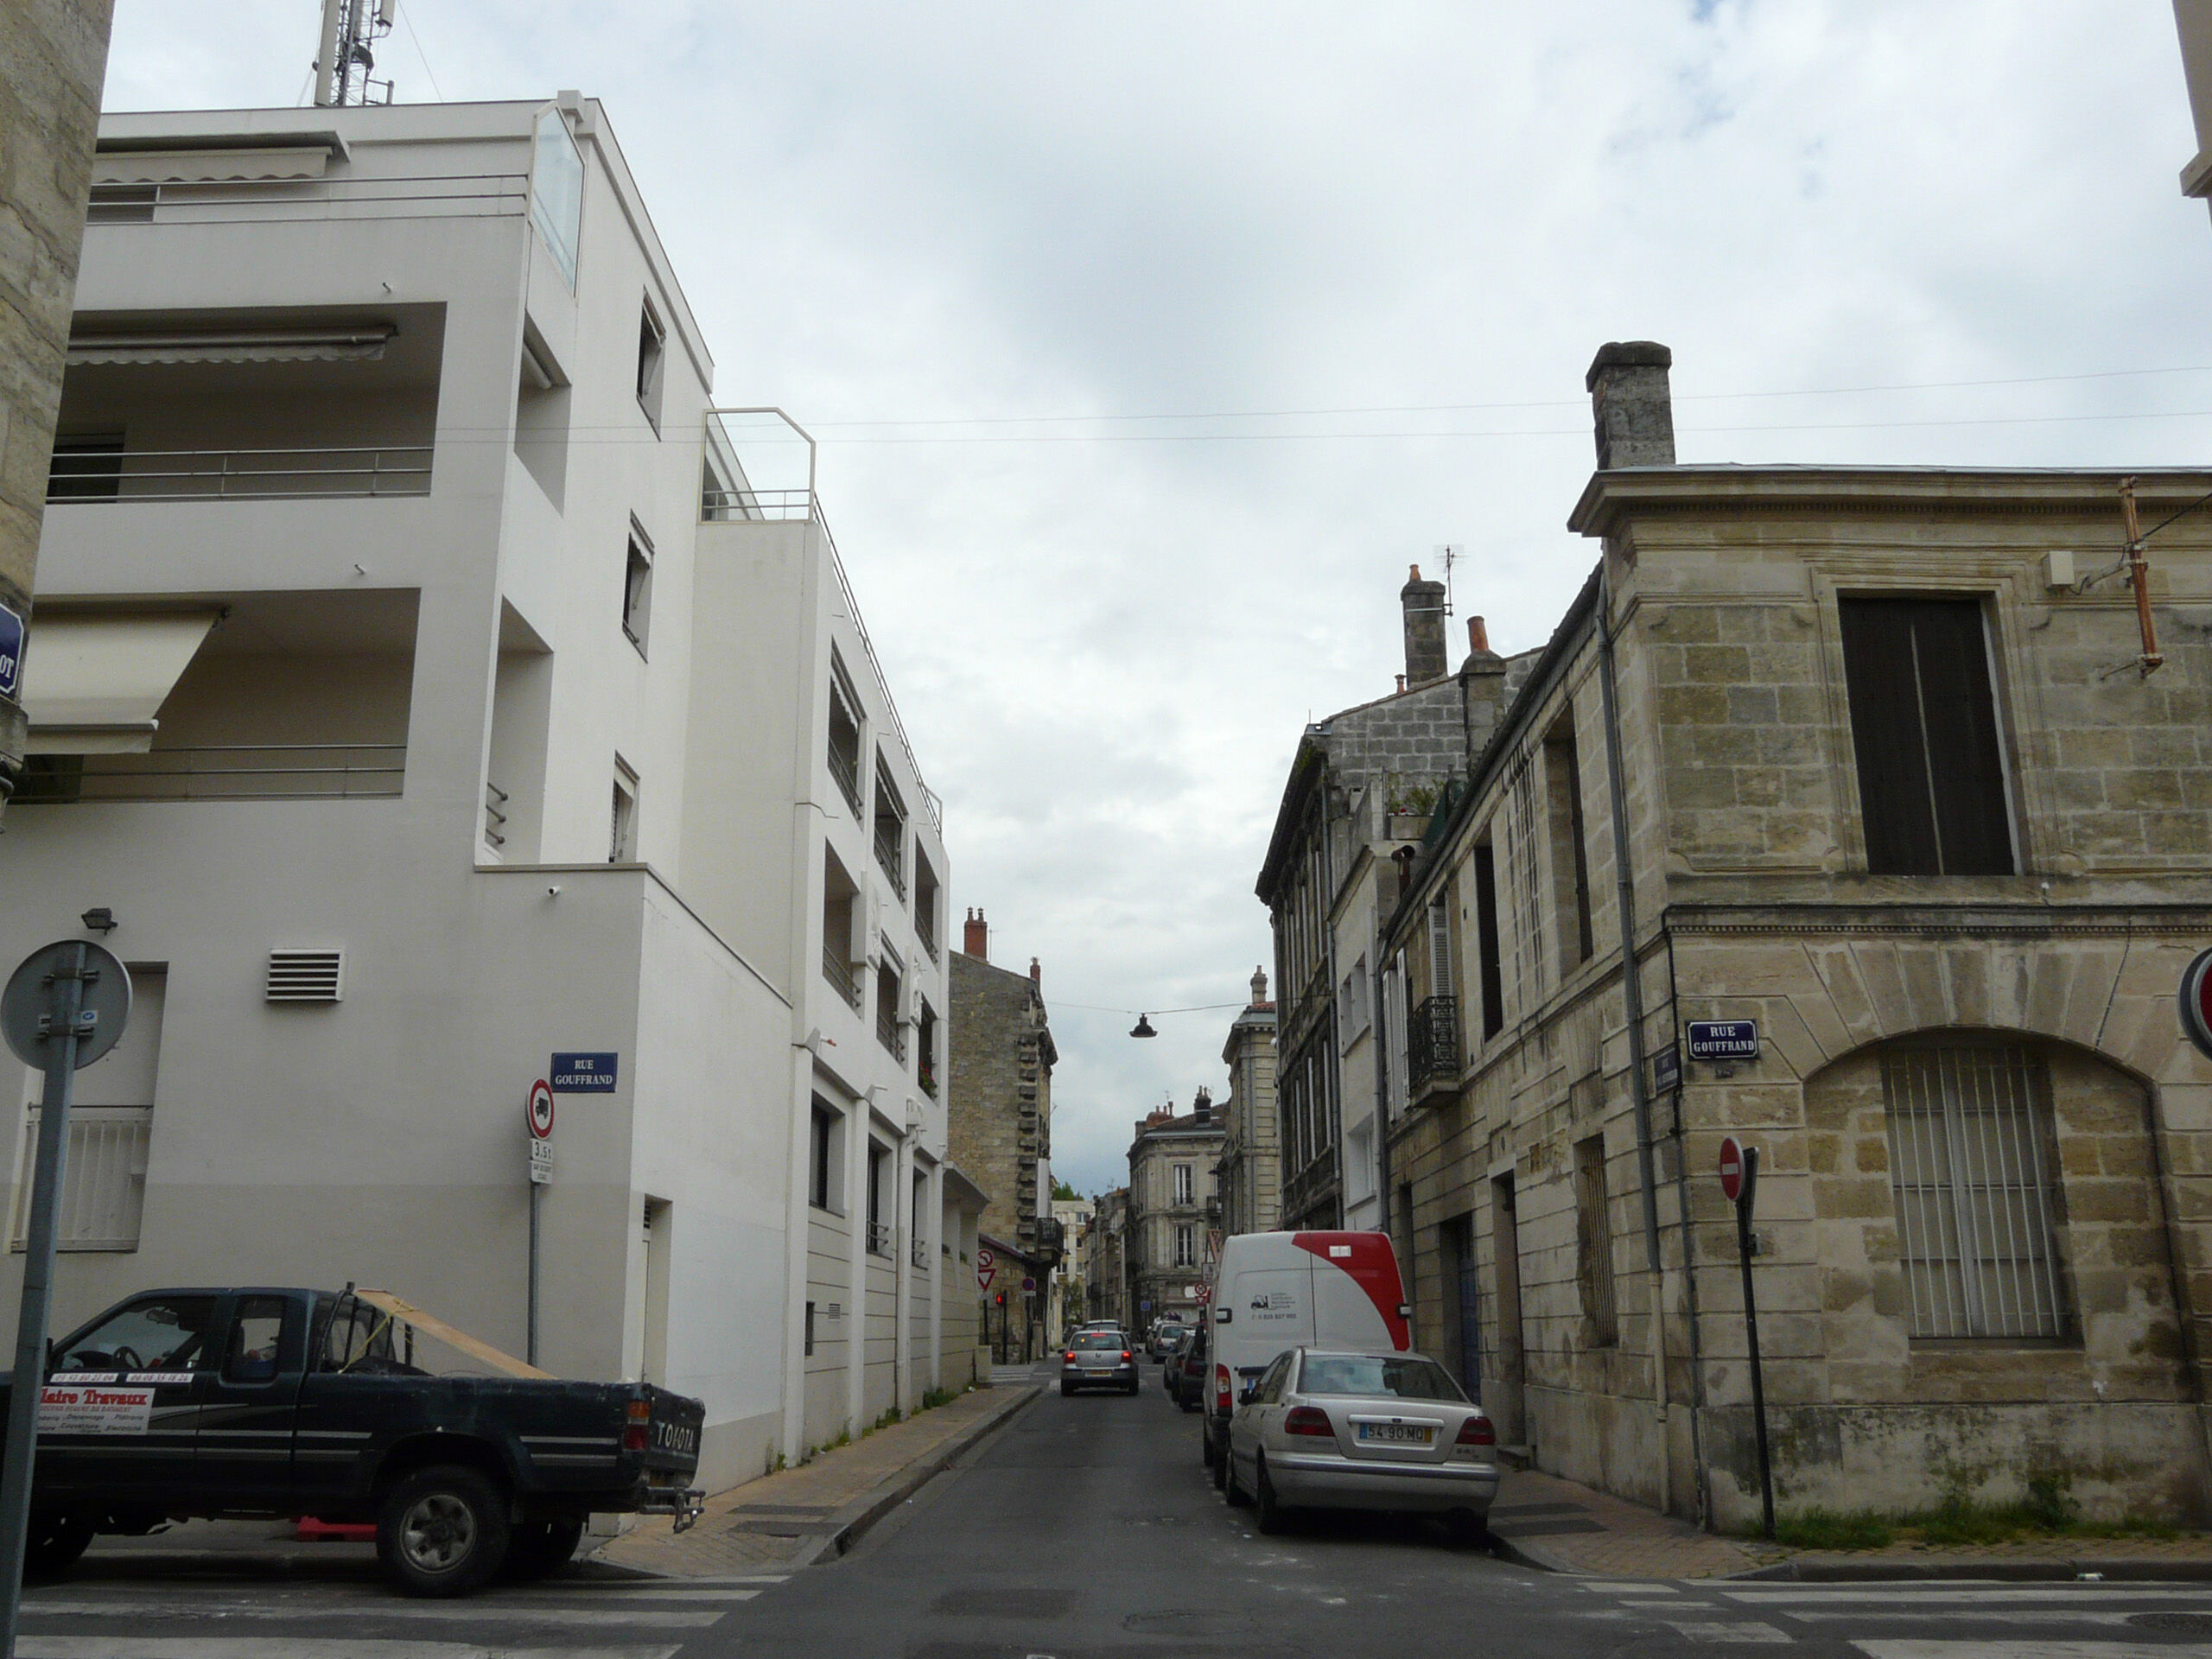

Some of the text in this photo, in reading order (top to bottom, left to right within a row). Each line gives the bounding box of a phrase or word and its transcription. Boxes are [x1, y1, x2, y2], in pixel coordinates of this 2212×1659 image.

[1710, 1026, 1736, 1037] RUE
[1694, 1040, 1755, 1052] GOUFFRAND
[575, 1059, 594, 1070] RUE
[555, 1075, 613, 1085] GOUFFRAND
[83, 1389, 148, 1405] Travaux
[656, 1421, 696, 1452] TOYOTA
